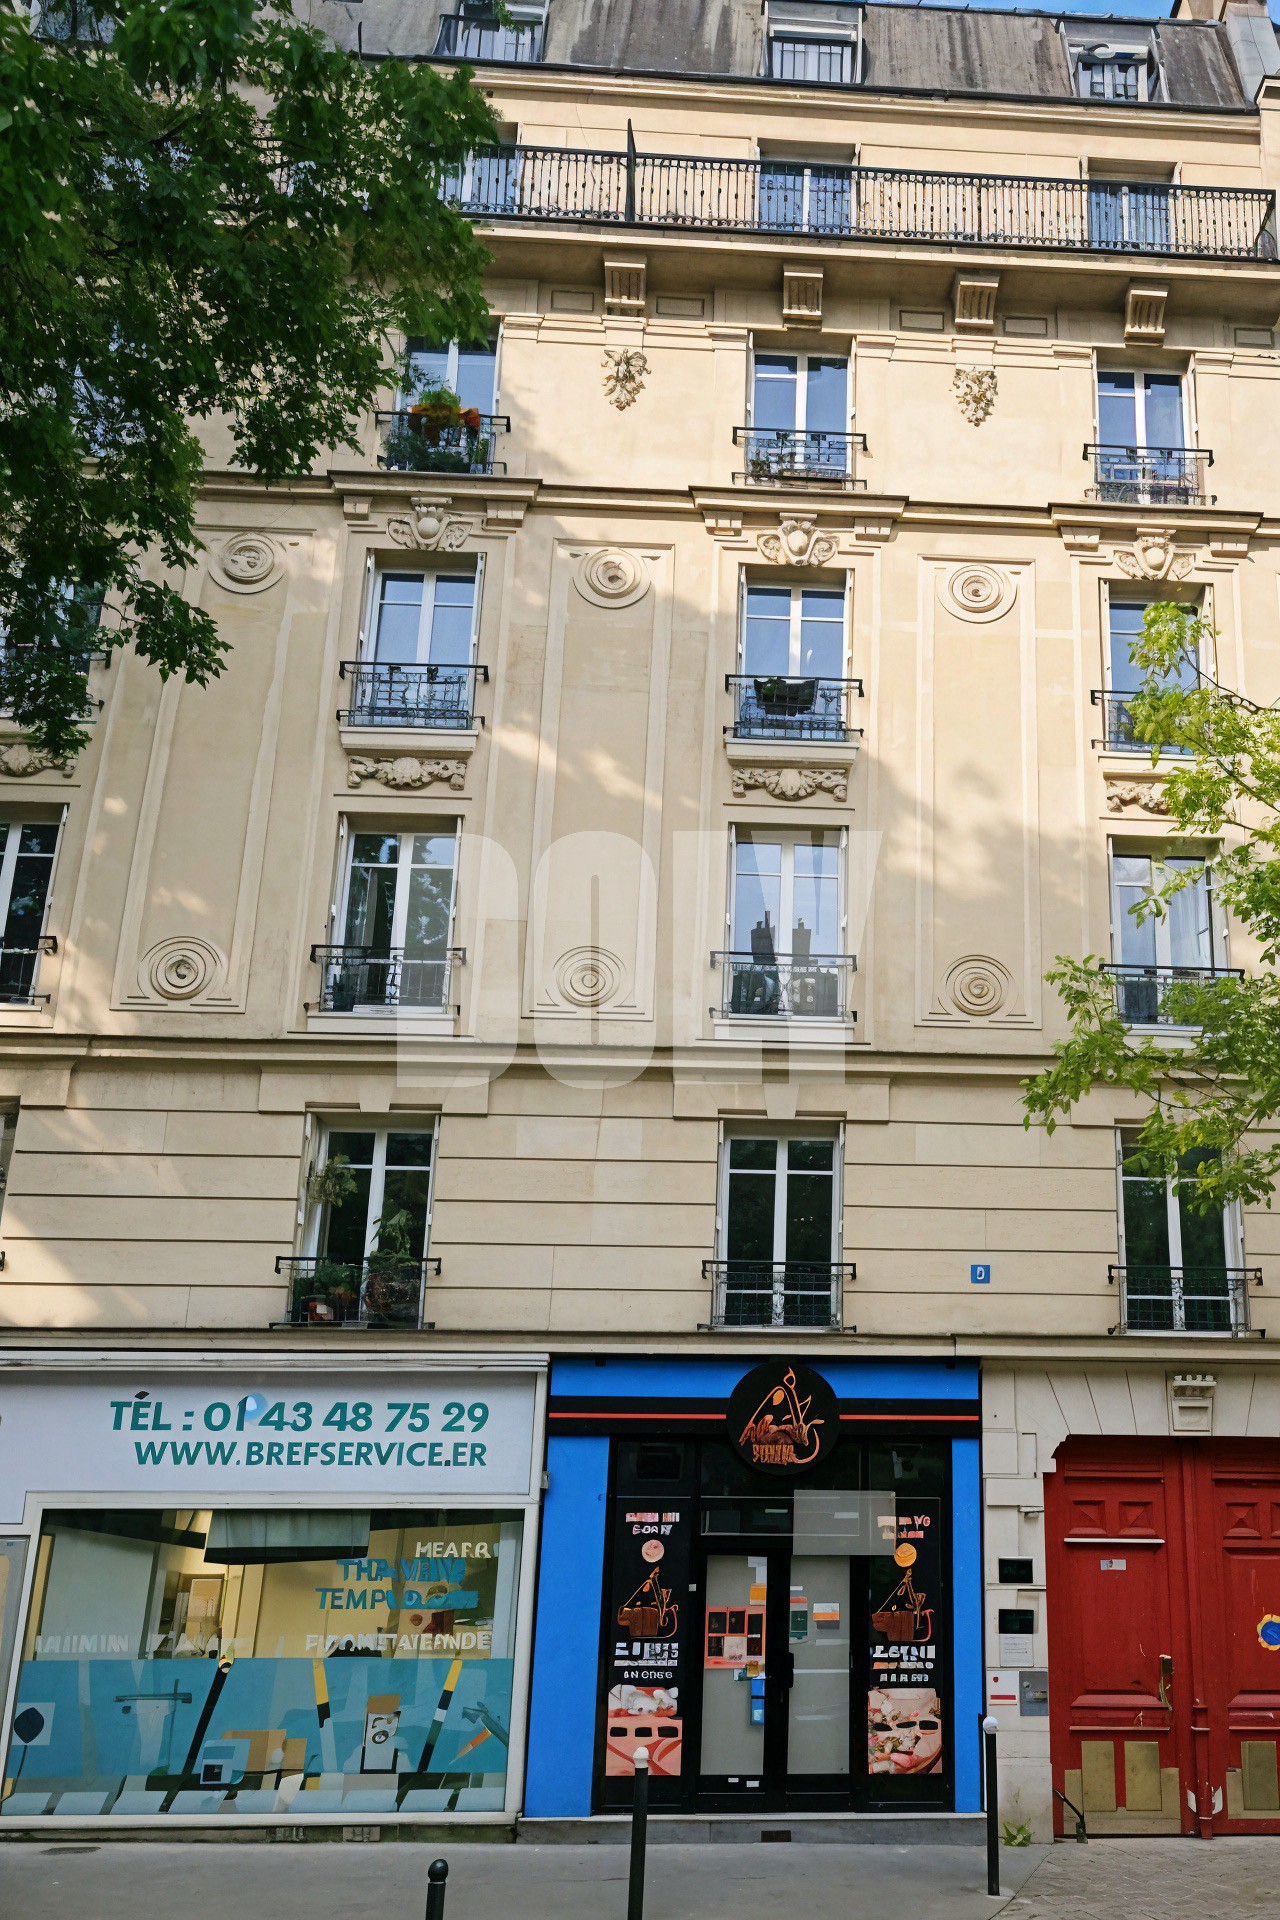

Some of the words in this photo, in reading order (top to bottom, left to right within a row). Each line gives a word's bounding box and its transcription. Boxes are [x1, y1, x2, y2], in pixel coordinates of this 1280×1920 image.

[110, 1391, 172, 1431] TÉL
[258, 1402, 313, 1432] 43
[322, 1402, 373, 1432] 48
[384, 1402, 430, 1433] 75
[440, 1402, 489, 1433] 29
